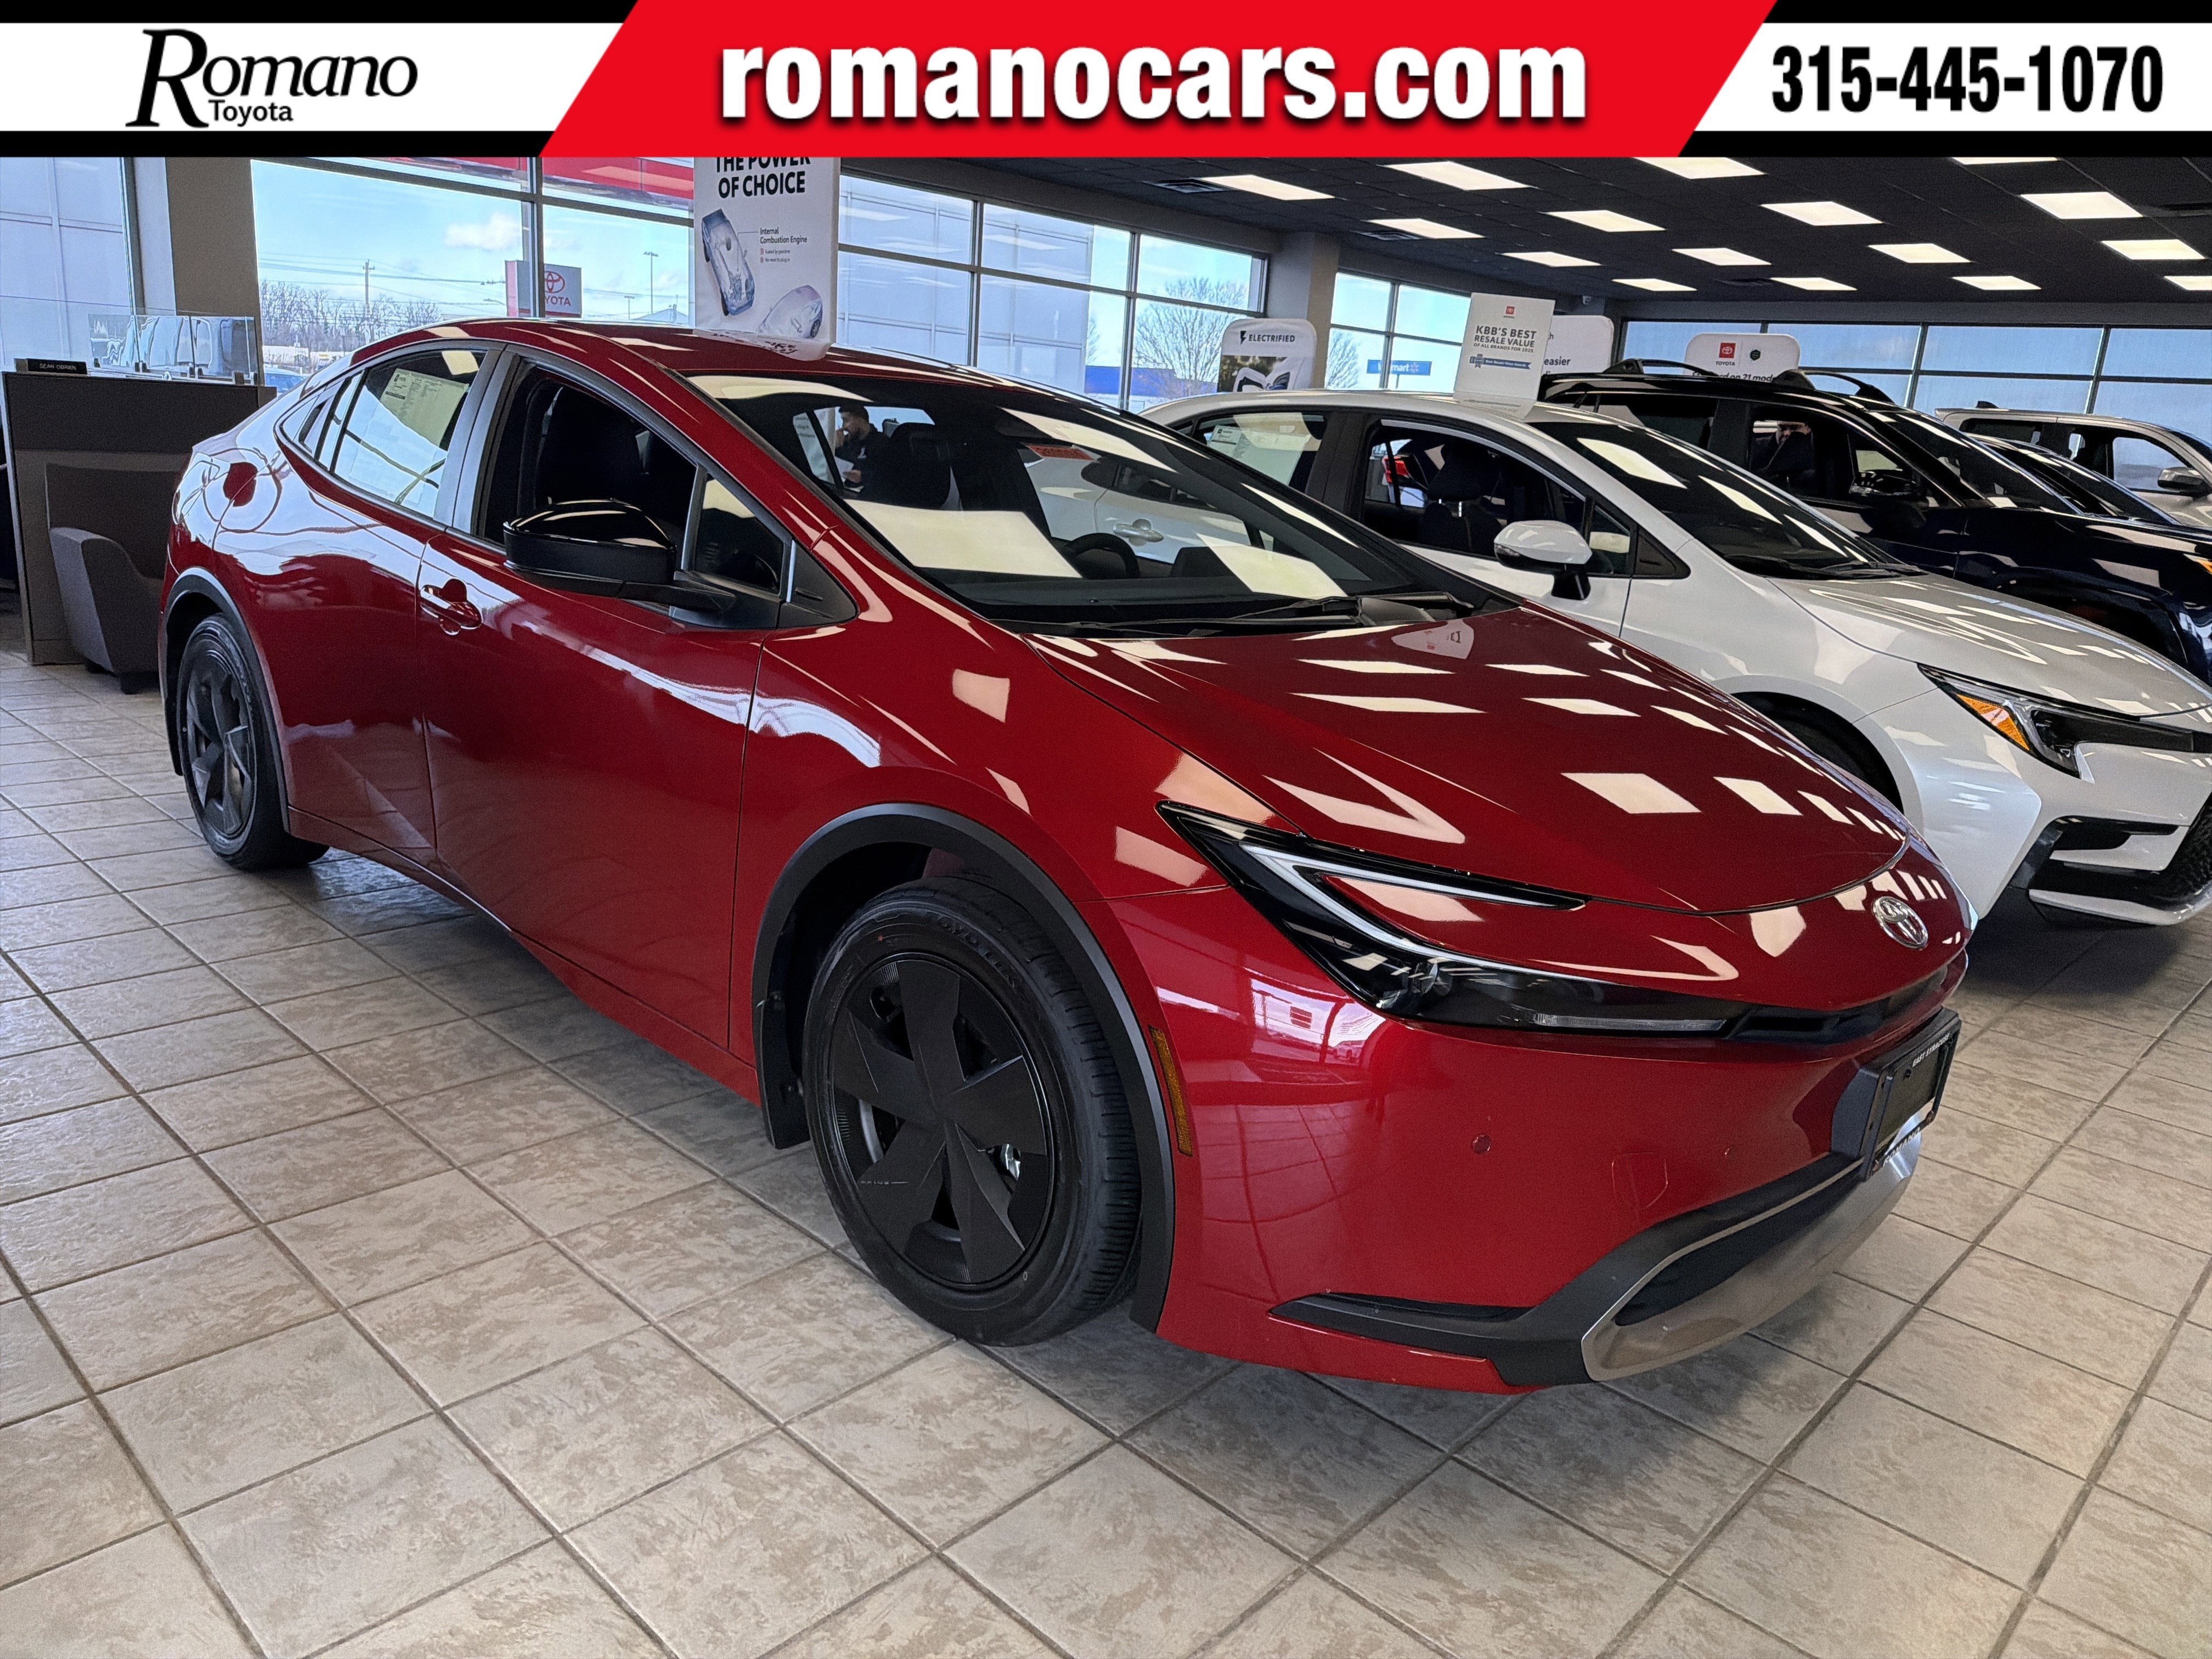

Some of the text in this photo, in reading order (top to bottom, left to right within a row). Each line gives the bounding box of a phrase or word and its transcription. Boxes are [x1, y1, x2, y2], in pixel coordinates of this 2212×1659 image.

[715, 157, 744, 173] THE
[718, 171, 805, 199] OF CHOICE
[760, 227, 779, 235] Internal
[760, 235, 808, 245] Combustion Engine
[545, 296, 571, 306] YOTA
[1476, 325, 1508, 336] KBB'S
[1510, 329, 1537, 340] BEST
[1248, 334, 1295, 342] ELECTRIFIED
[1474, 335, 1536, 348] RESALE VALUE
[1544, 356, 1571, 366] easier
[1742, 373, 1752, 381] 21
[1882, 1126, 1921, 1168] ROMANO
